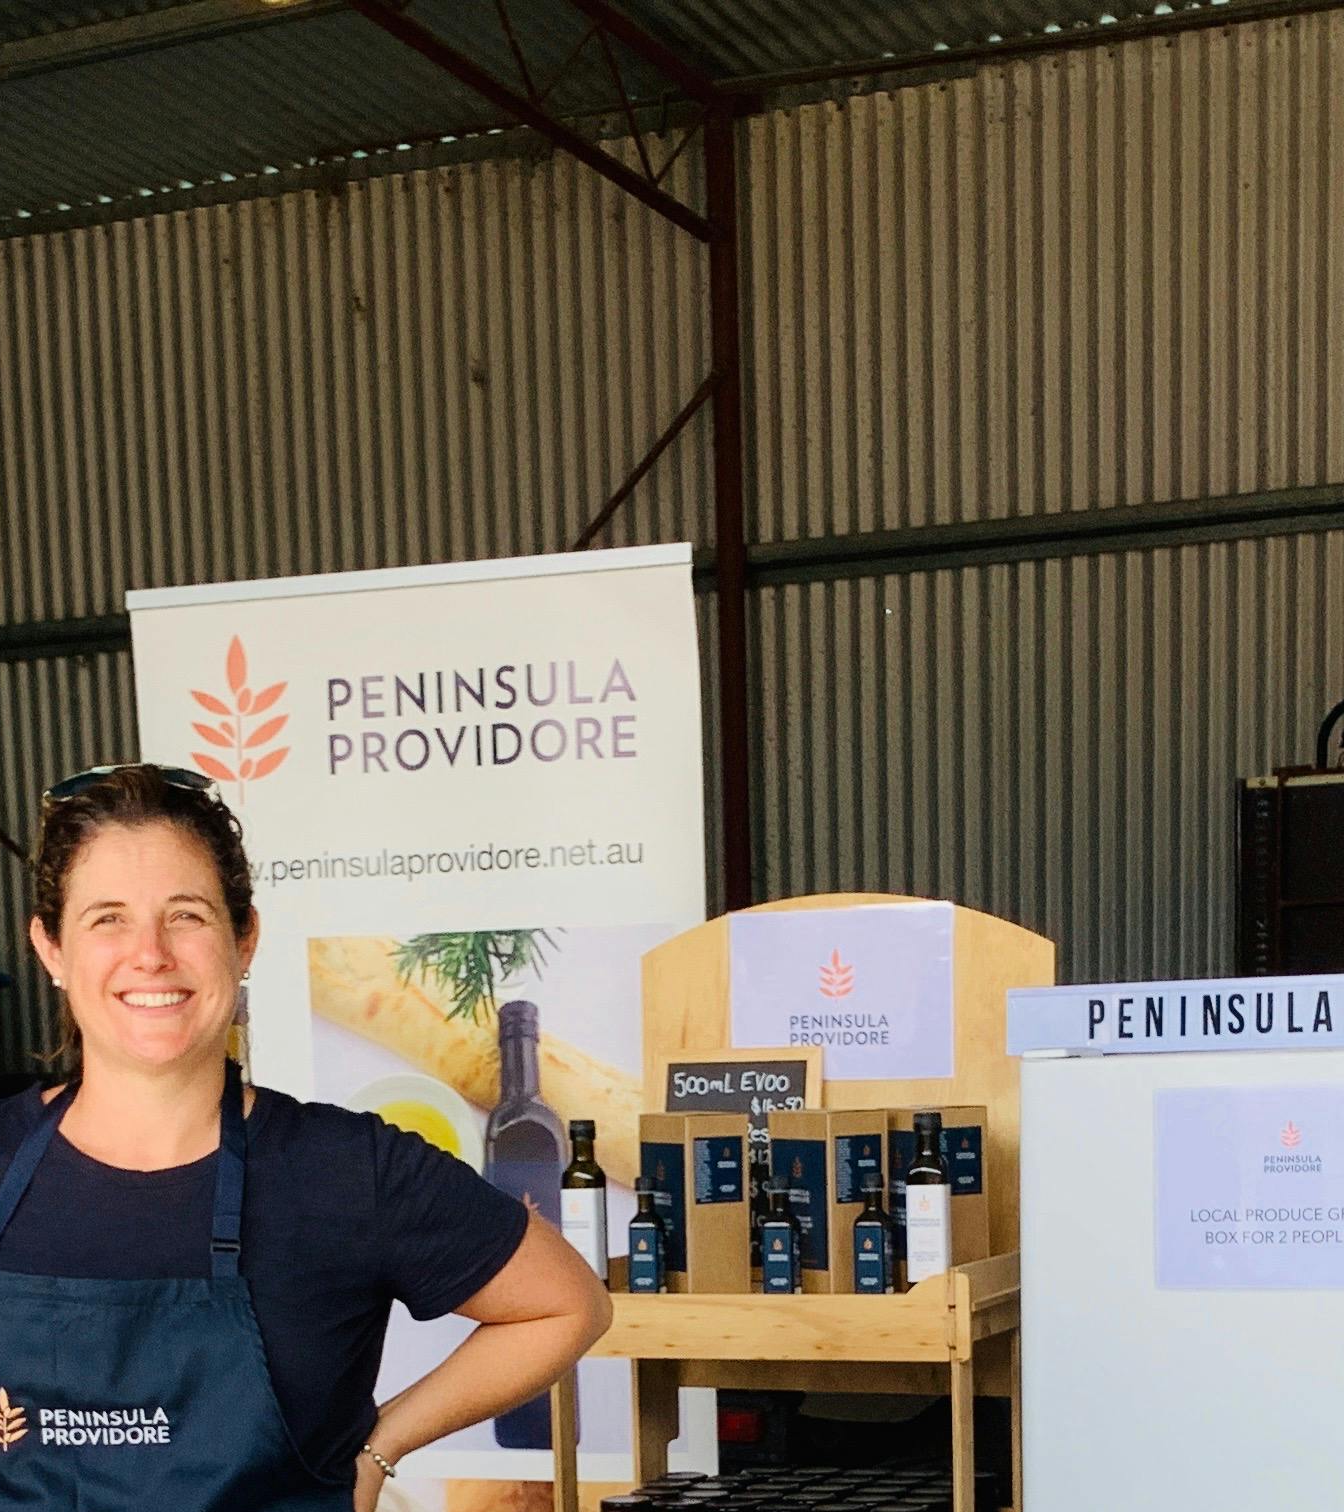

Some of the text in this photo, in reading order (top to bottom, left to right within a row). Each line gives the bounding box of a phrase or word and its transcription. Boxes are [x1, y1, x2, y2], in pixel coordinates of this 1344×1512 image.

[328, 658, 637, 720] PENINSULA
[330, 714, 638, 774] PROVIDORE
[789, 1014, 889, 1031] PENINSULA
[1087, 990, 1335, 1041] PENINSULA
[789, 1029, 890, 1047] PROVIDORE
[1264, 1155, 1322, 1163] PENINSULA
[1264, 1163, 1322, 1173] PROVIDORE
[1190, 1209, 1240, 1223] LOCAL
[1245, 1208, 1323, 1222] PRODUCE
[1205, 1231, 1238, 1244] BOX
[1243, 1231, 1274, 1244] FOR
[1279, 1231, 1286, 1244] 2
[39, 1407, 169, 1427] PENINSULA
[41, 1425, 171, 1446] PROVIDORE
